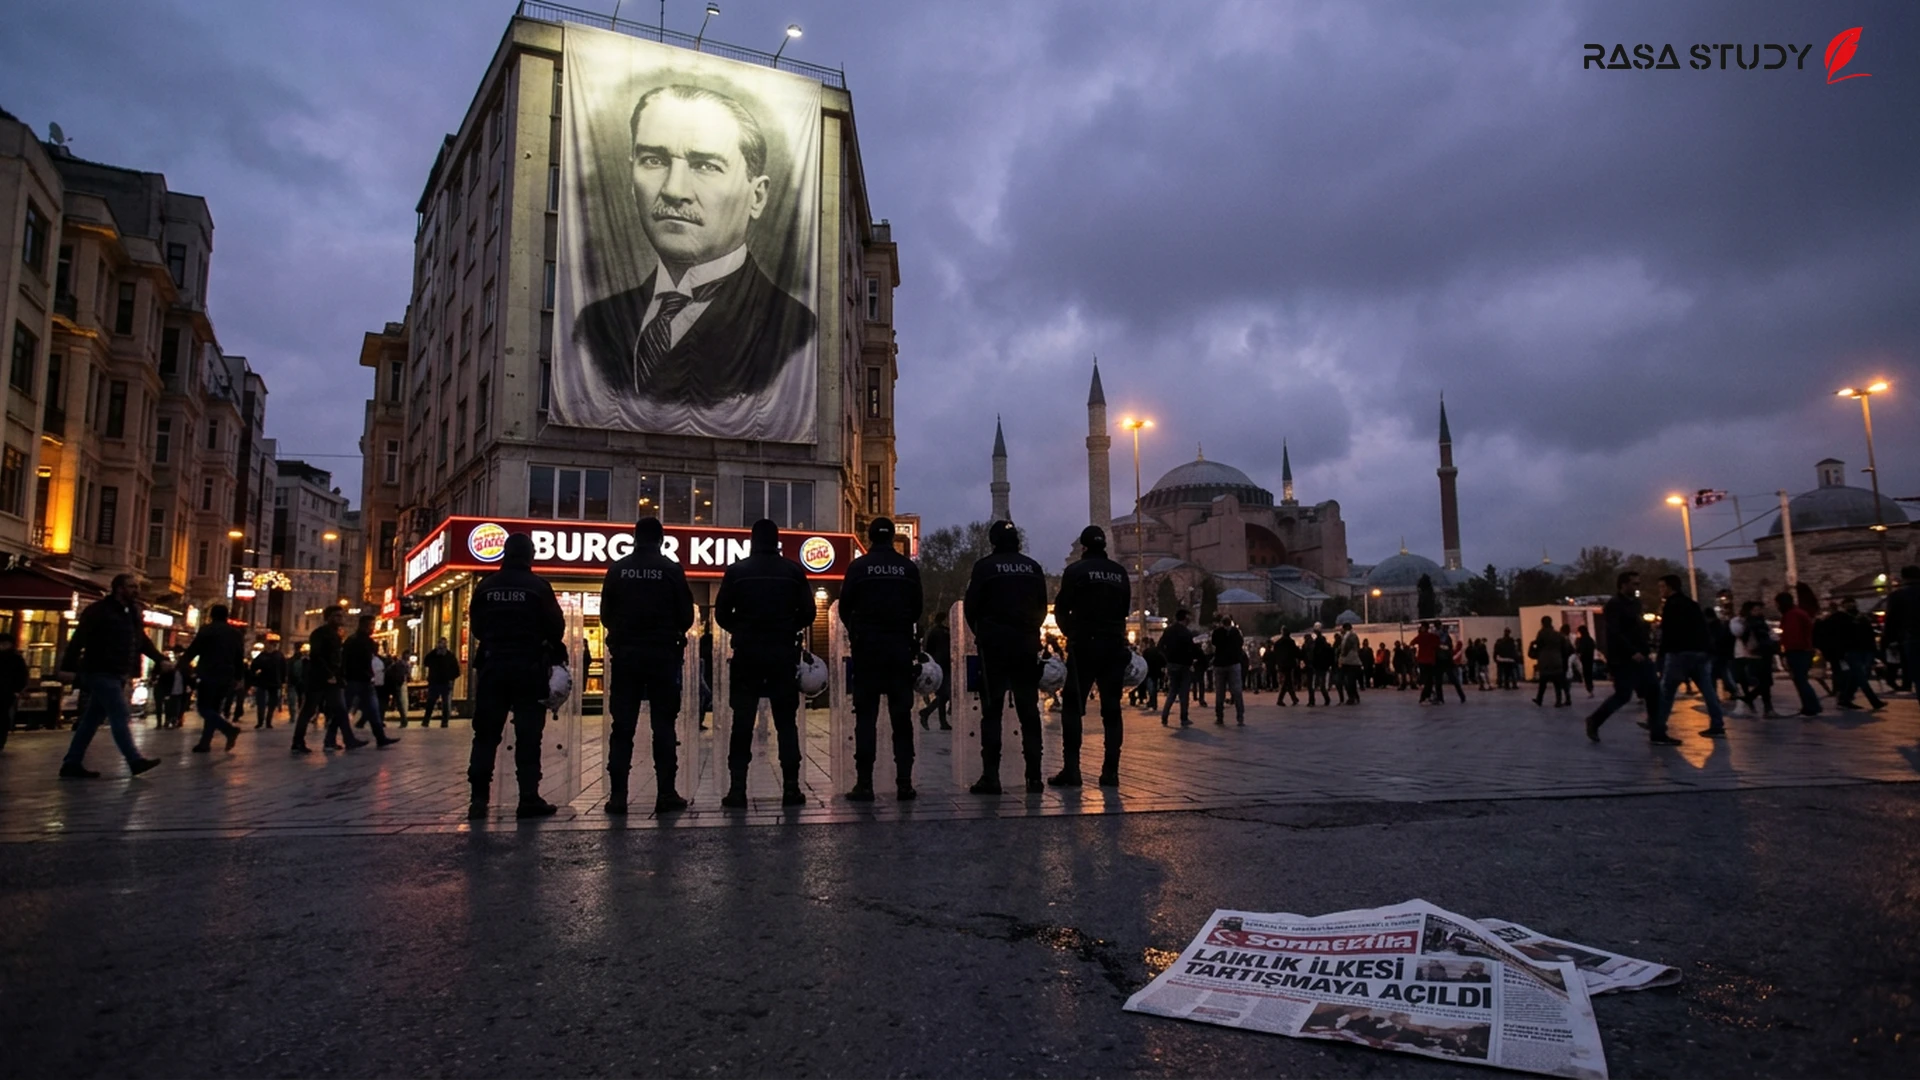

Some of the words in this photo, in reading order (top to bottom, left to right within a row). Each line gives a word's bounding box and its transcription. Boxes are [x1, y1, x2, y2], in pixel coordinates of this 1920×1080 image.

[531, 529, 680, 564] BURGR
[1308, 955, 1405, 981] İLKESİ
[1184, 961, 1370, 998] TARTIŞMAYA
[1378, 983, 1493, 1011] AÇILDI
